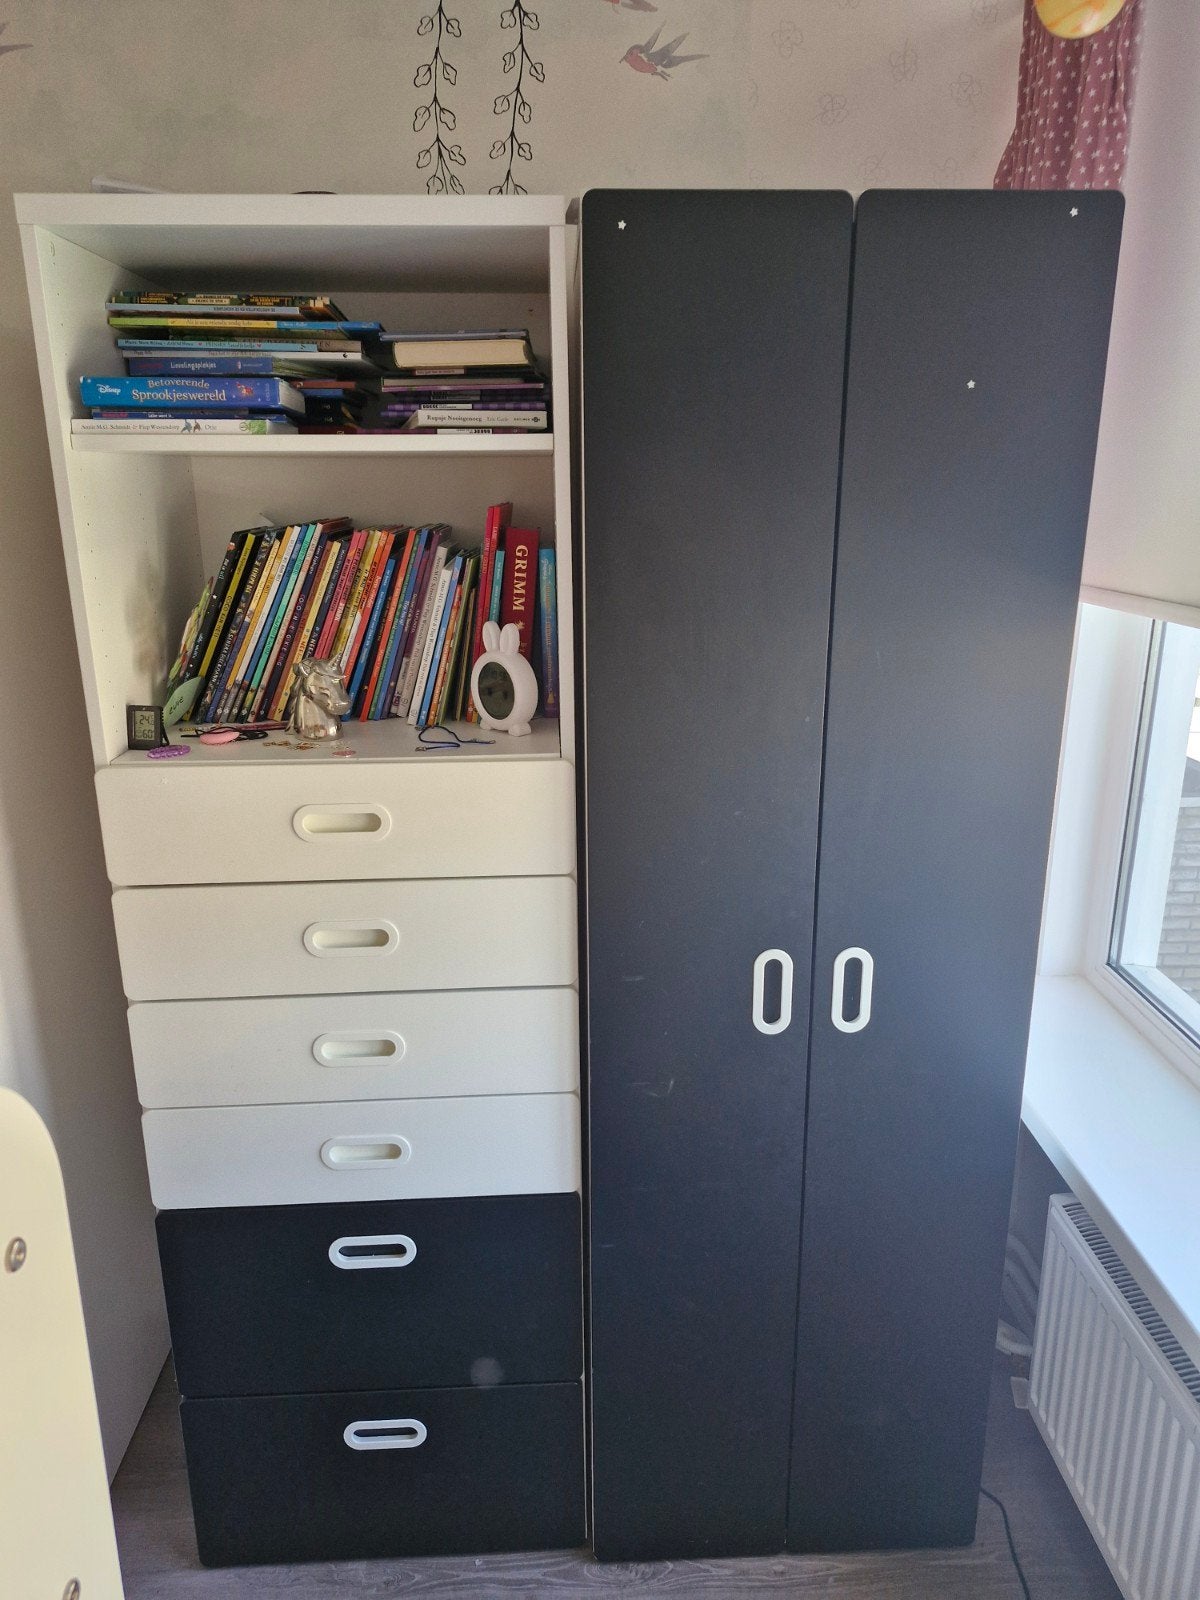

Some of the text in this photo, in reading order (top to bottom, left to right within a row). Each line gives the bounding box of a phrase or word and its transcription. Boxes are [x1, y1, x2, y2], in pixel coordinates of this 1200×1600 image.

[97, 383, 121, 395] Disney
[147, 377, 210, 389] Betoverende
[132, 389, 227, 403] Sprookjeswereld
[512, 544, 529, 612] GRIMM
[222, 595, 232, 611] COCO
[140, 715, 150, 725] 24
